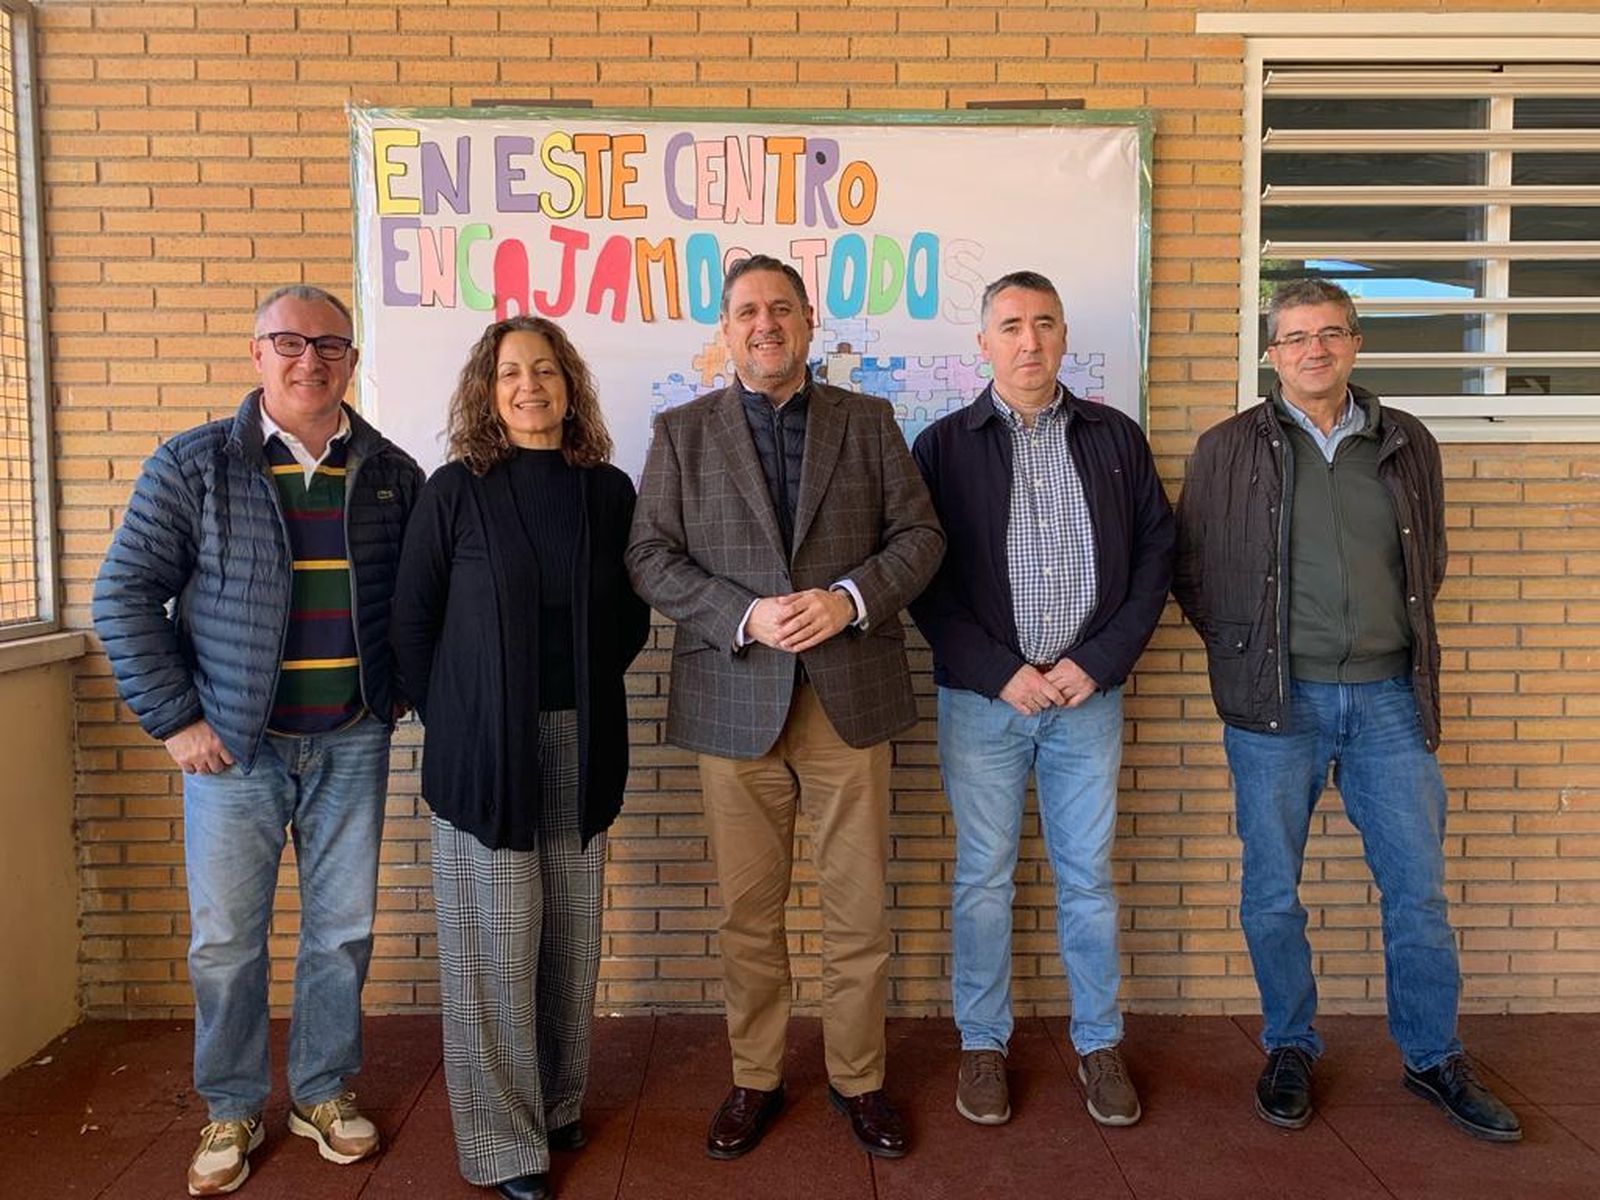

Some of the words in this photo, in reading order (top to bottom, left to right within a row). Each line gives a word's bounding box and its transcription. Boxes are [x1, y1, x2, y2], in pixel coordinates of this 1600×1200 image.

[373, 128, 471, 215] EN
[494, 131, 647, 220] ESTE
[664, 131, 878, 229] CENTRO
[790, 231, 986, 327] TODOS
